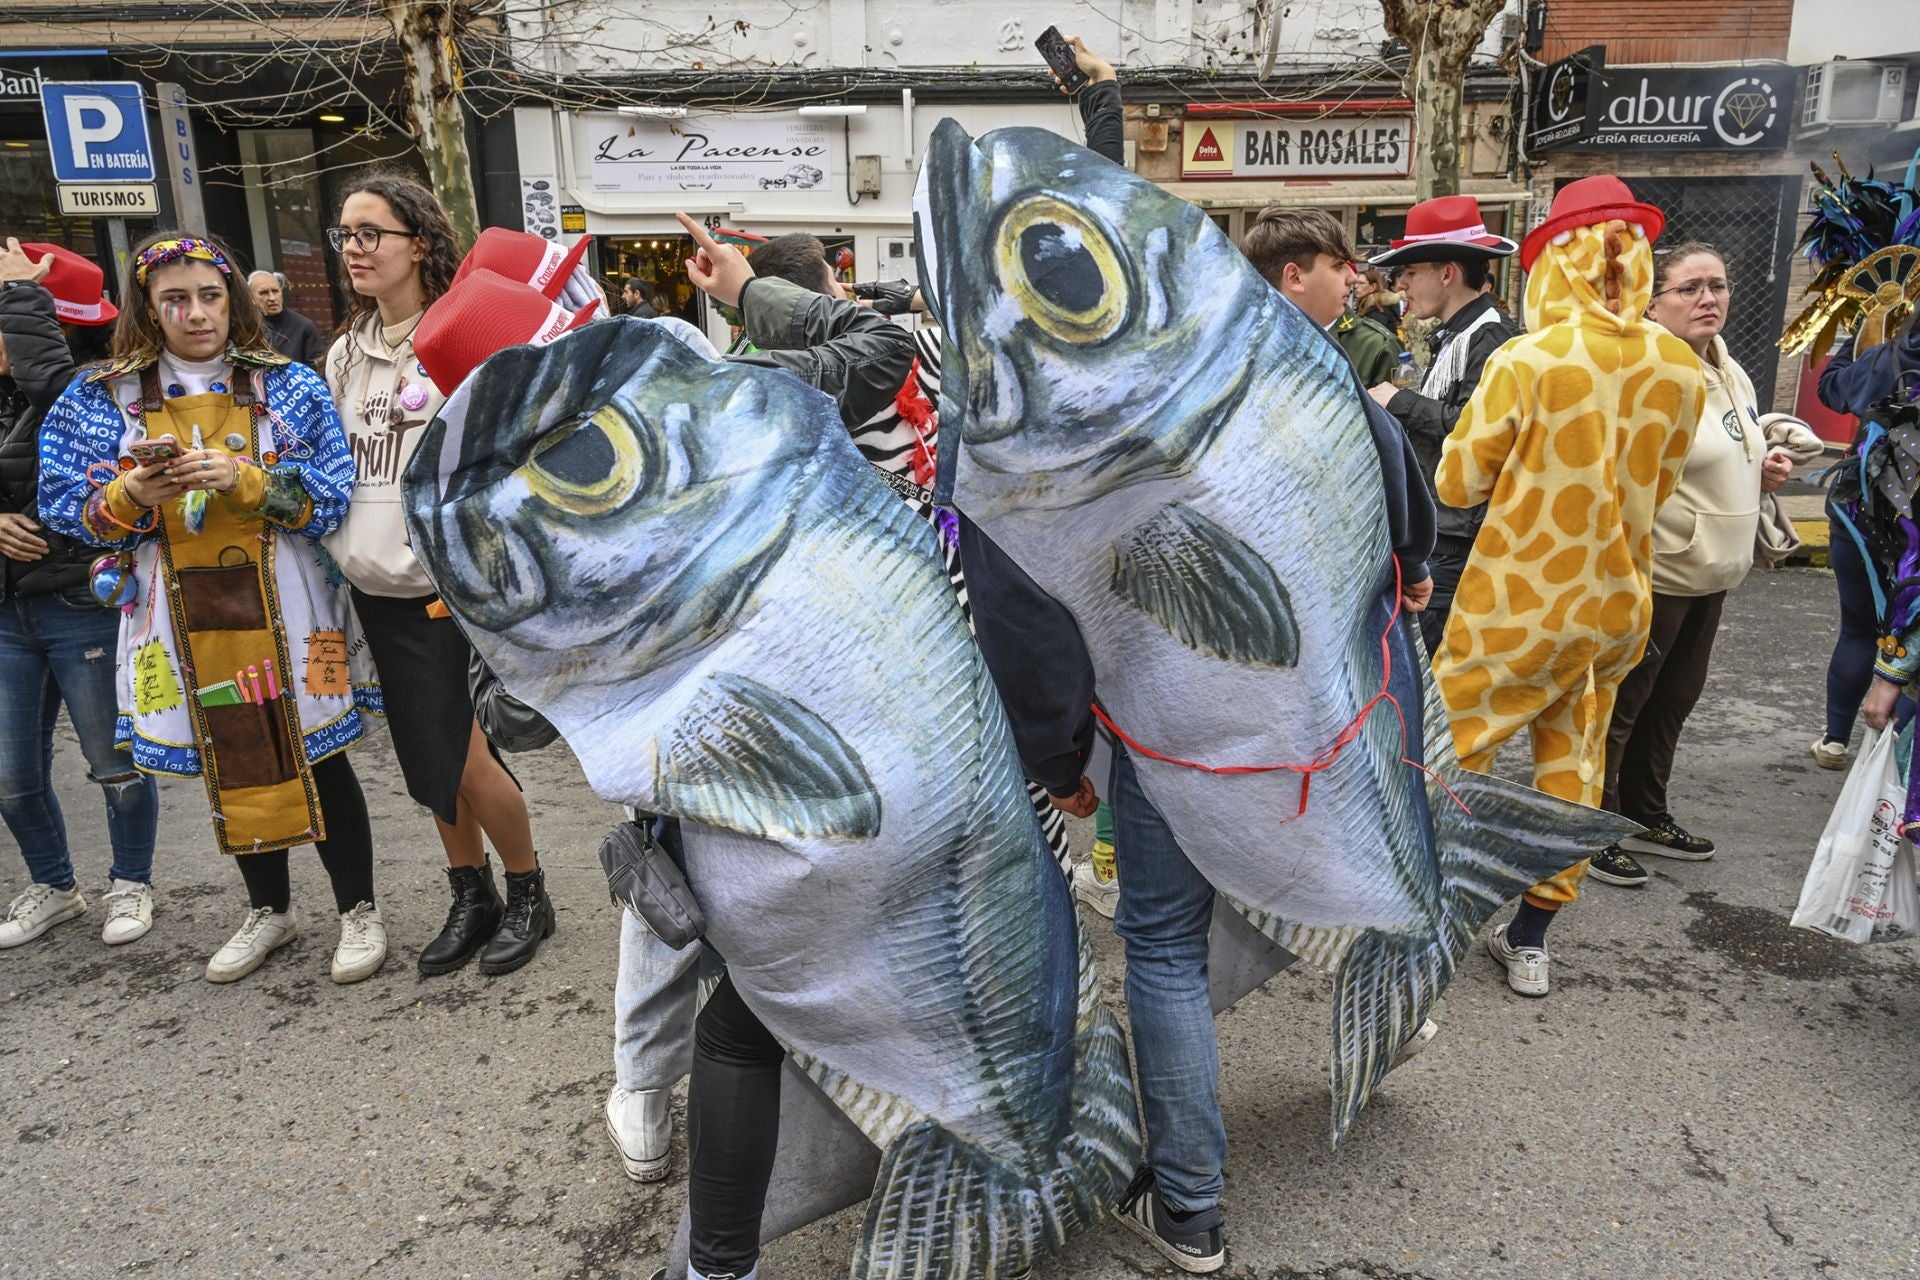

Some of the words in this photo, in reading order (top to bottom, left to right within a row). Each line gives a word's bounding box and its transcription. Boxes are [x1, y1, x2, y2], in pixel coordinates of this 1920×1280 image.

[1599, 78, 1711, 125] abur
[63, 95, 124, 168] P
[1630, 131, 1701, 144] RELOJERÍA
[175, 118, 193, 185] BUS
[594, 134, 655, 161] La
[675, 133, 827, 162] Pacense
[1199, 145, 1217, 154] Delta
[1245, 130, 1290, 166] BAR
[1299, 128, 1400, 165] ROSALES
[90, 154, 105, 169] EN
[107, 150, 149, 169] BATERÍA
[638, 173, 655, 181] Pan
[667, 172, 695, 181] dulces
[698, 172, 756, 180] tradicionales
[72, 191, 146, 207] TURISMOS
[704, 215, 721, 229] 46
[294, 400, 313, 418] Los
[44, 432, 64, 445] Los
[43, 445, 58, 456] es
[63, 452, 77, 463] el
[164, 759, 183, 771] Las
[1175, 1242, 1202, 1255] adidas
